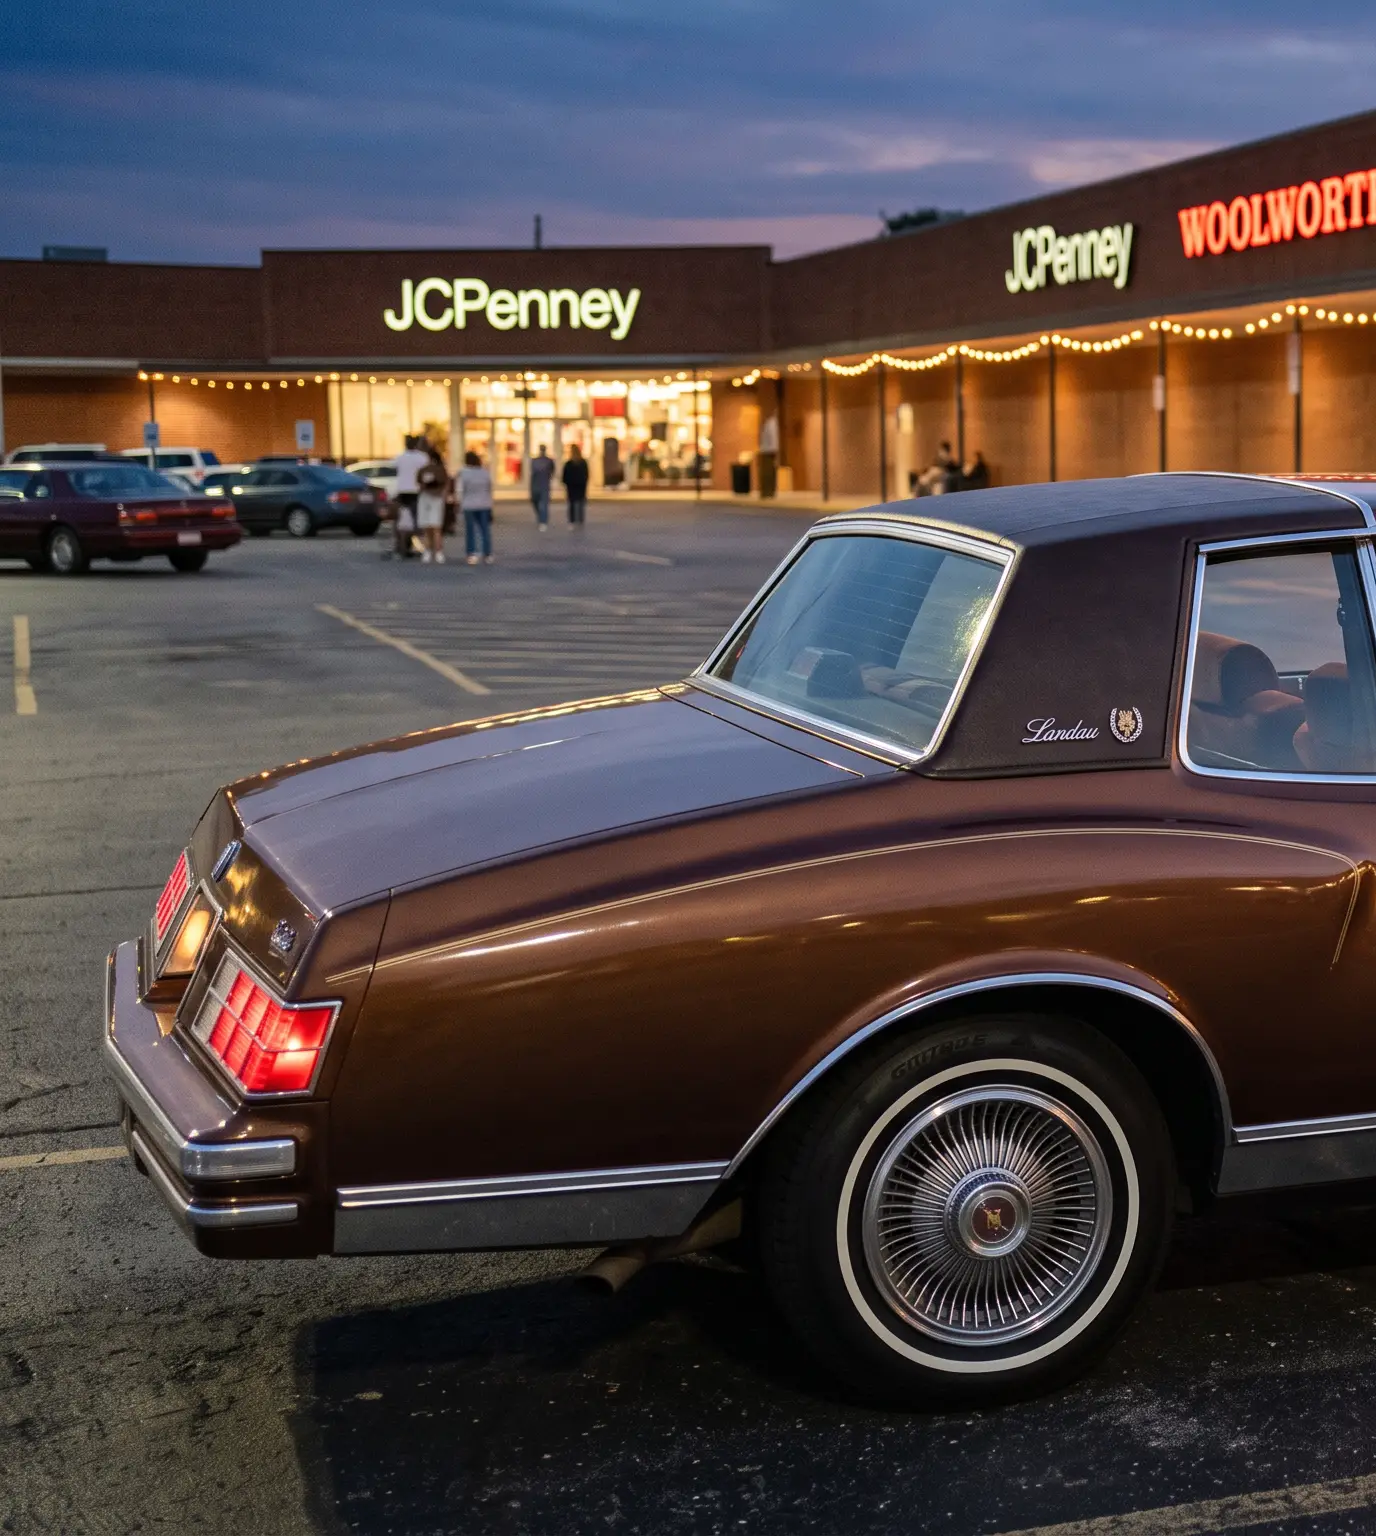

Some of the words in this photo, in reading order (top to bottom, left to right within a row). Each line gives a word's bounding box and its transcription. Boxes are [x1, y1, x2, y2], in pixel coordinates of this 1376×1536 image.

[1005, 222, 1133, 293] JCPenney
[383, 277, 641, 340] JCPenney
[1021, 717, 1100, 743] Landau
